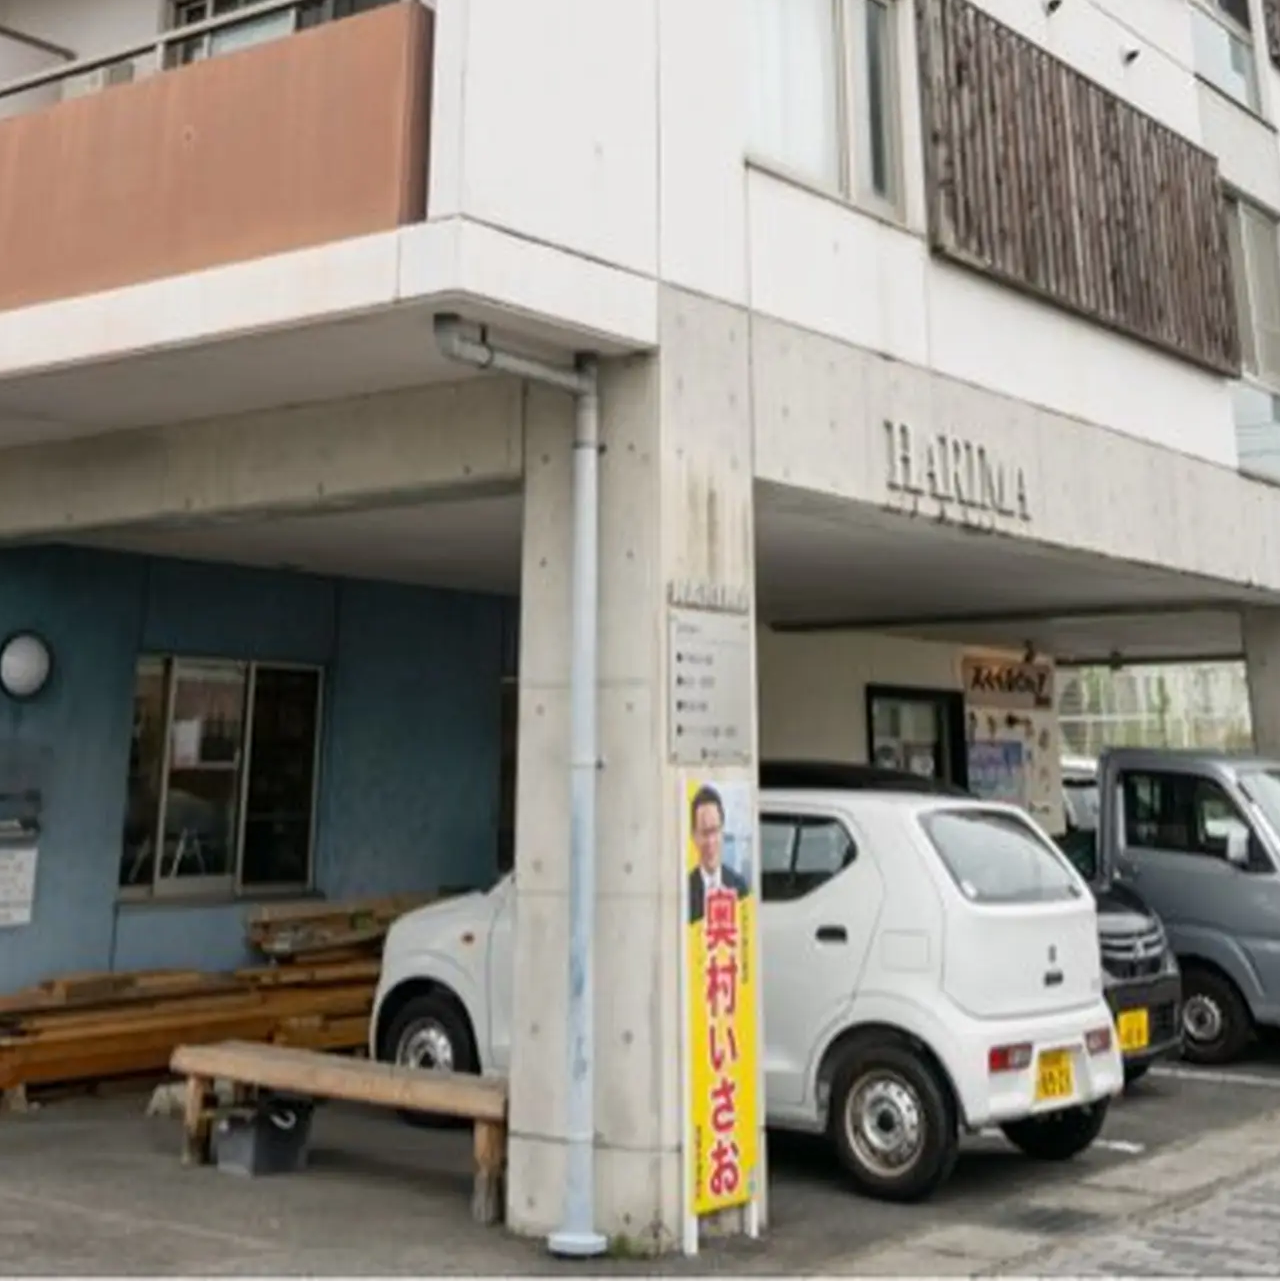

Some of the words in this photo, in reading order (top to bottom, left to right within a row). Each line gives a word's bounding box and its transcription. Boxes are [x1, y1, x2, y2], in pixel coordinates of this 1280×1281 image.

[705, 887, 740, 1196] 奥村いさお
